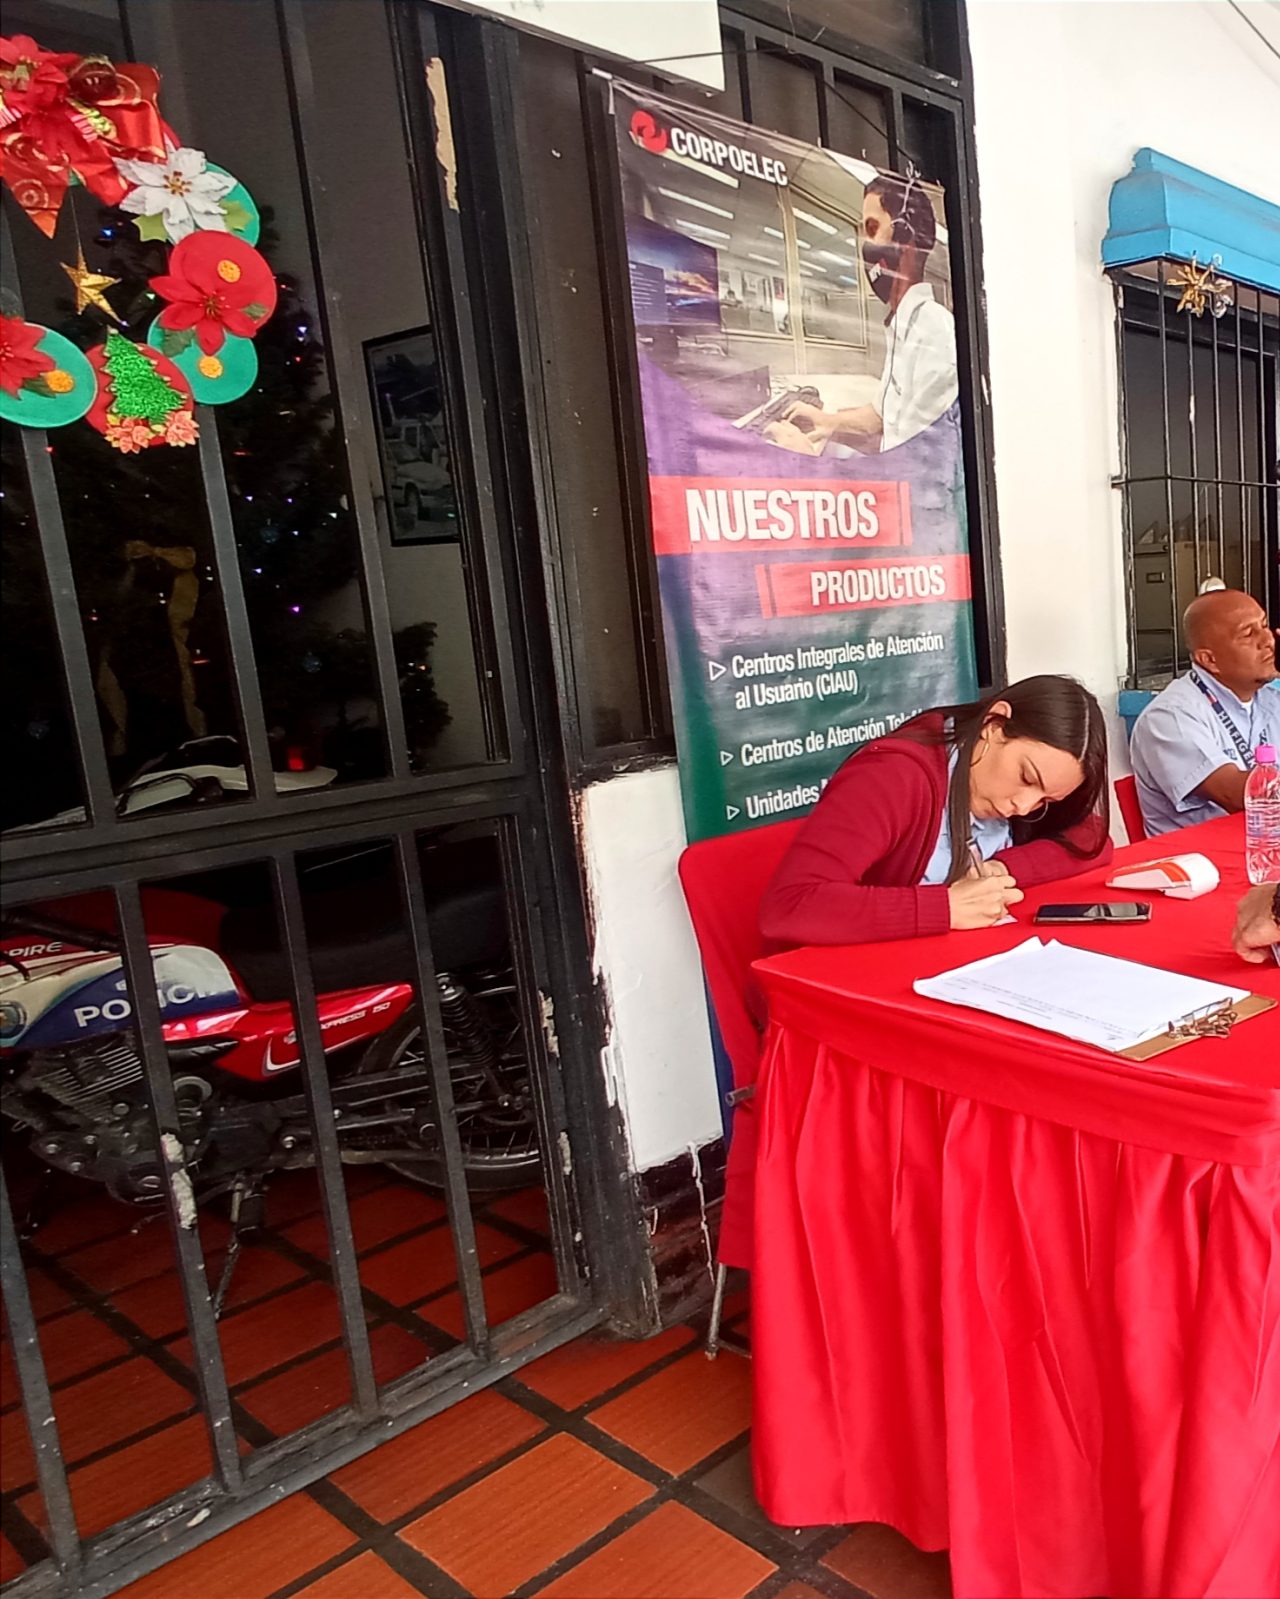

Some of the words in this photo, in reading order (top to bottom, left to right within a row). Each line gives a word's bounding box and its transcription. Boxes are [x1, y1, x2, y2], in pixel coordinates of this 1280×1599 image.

[670, 127, 788, 186] CORPOELEC
[685, 489, 880, 542] NUESTROS
[810, 564, 946, 606] PRODUCTOS
[731, 651, 795, 679] Centros
[797, 641, 865, 670] Integrales
[867, 638, 885, 659] de
[886, 630, 944, 657] Atención
[735, 685, 751, 710] al
[753, 678, 814, 707] Usuario
[816, 669, 859, 701] (CIAU)
[740, 738, 803, 767] Centros
[805, 730, 825, 753] de
[826, 717, 886, 749] Atención
[745, 785, 820, 819] Unidades
